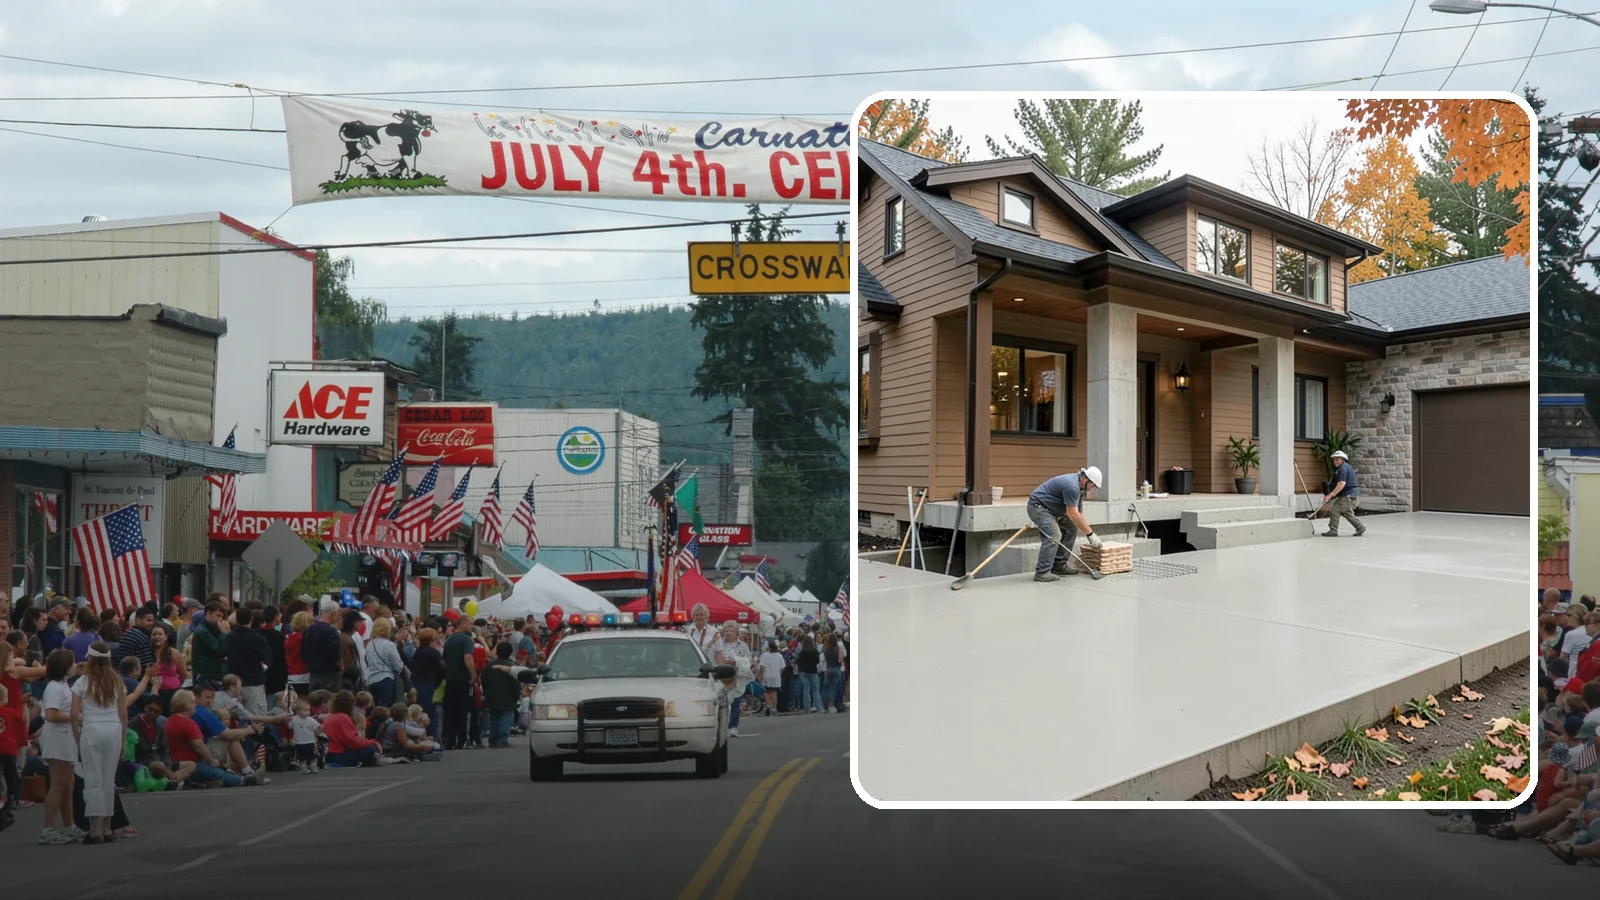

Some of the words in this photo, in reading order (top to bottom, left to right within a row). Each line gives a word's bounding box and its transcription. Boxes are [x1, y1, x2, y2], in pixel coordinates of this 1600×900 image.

[481, 141, 605, 192] JULY
[632, 150, 746, 198] 4th.
[697, 254, 850, 280] CROSSWA
[283, 380, 373, 420] ACE
[405, 409, 452, 422] CEDAR
[461, 409, 485, 422] LOG
[283, 421, 370, 436] Hardware
[416, 428, 476, 447] Coca-Cola
[353, 467, 386, 478] Simpl
[83, 485, 93, 494] St.
[96, 485, 124, 494] Vincent
[126, 486, 135, 494] de
[137, 486, 155, 495] Paul
[688, 526, 741, 535] CRNATION
[699, 535, 730, 544] GLASS
